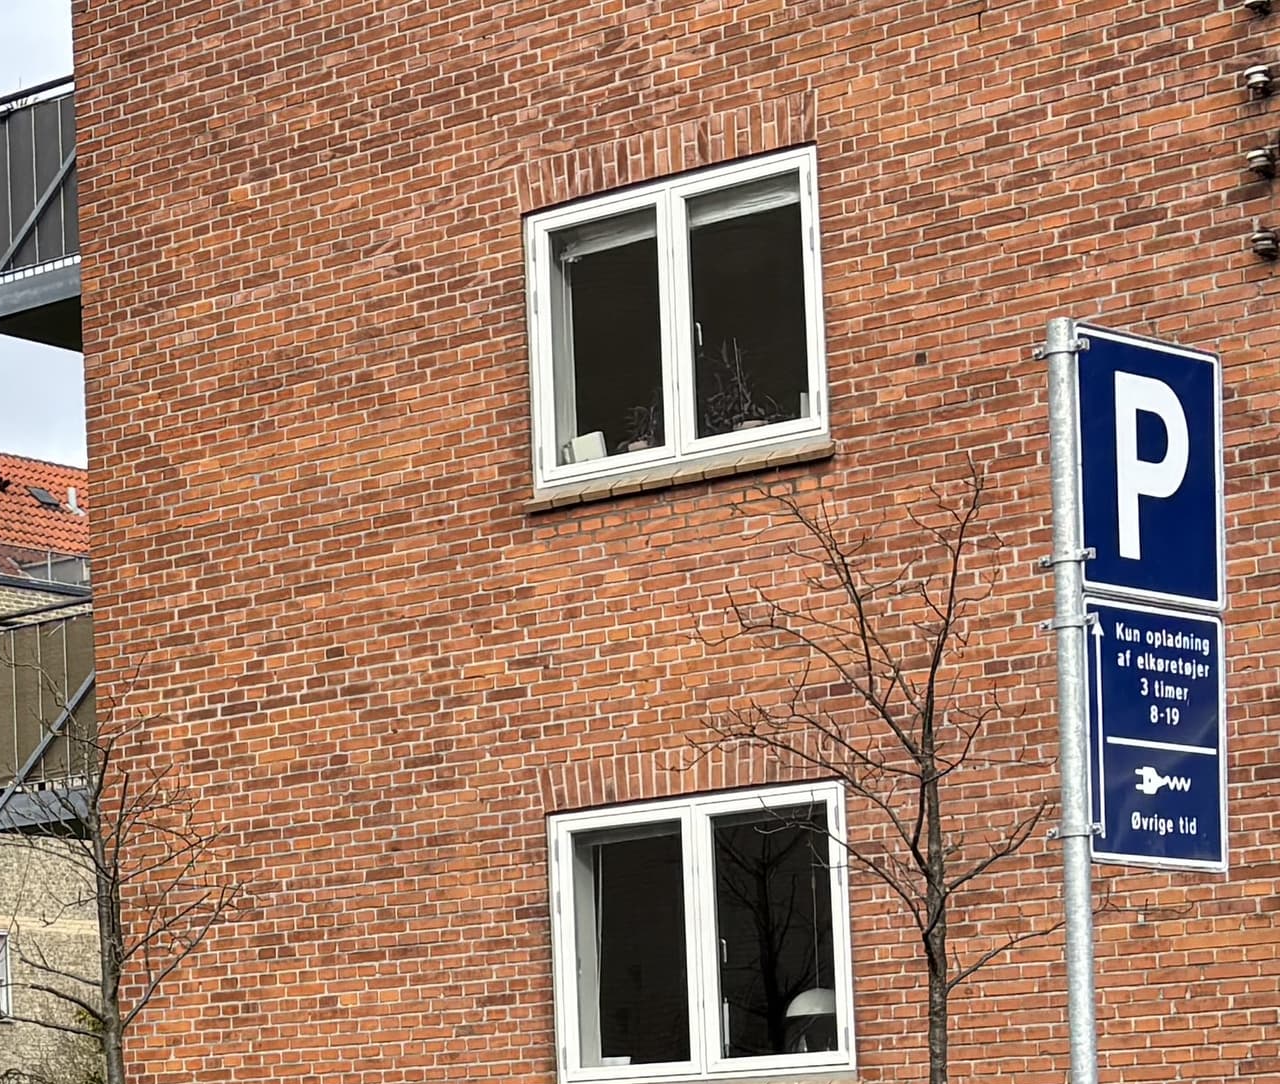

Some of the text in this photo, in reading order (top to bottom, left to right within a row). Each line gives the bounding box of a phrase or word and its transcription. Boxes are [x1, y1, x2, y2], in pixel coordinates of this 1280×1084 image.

[1114, 369, 1190, 561] P
[1115, 621, 1210, 656] Kun opladning
[1117, 649, 1210, 680] af elkøretøjer
[1139, 677, 1189, 701] 3 timer
[1149, 704, 1180, 726] 8-19
[1131, 811, 1197, 836] Øvrige tid
